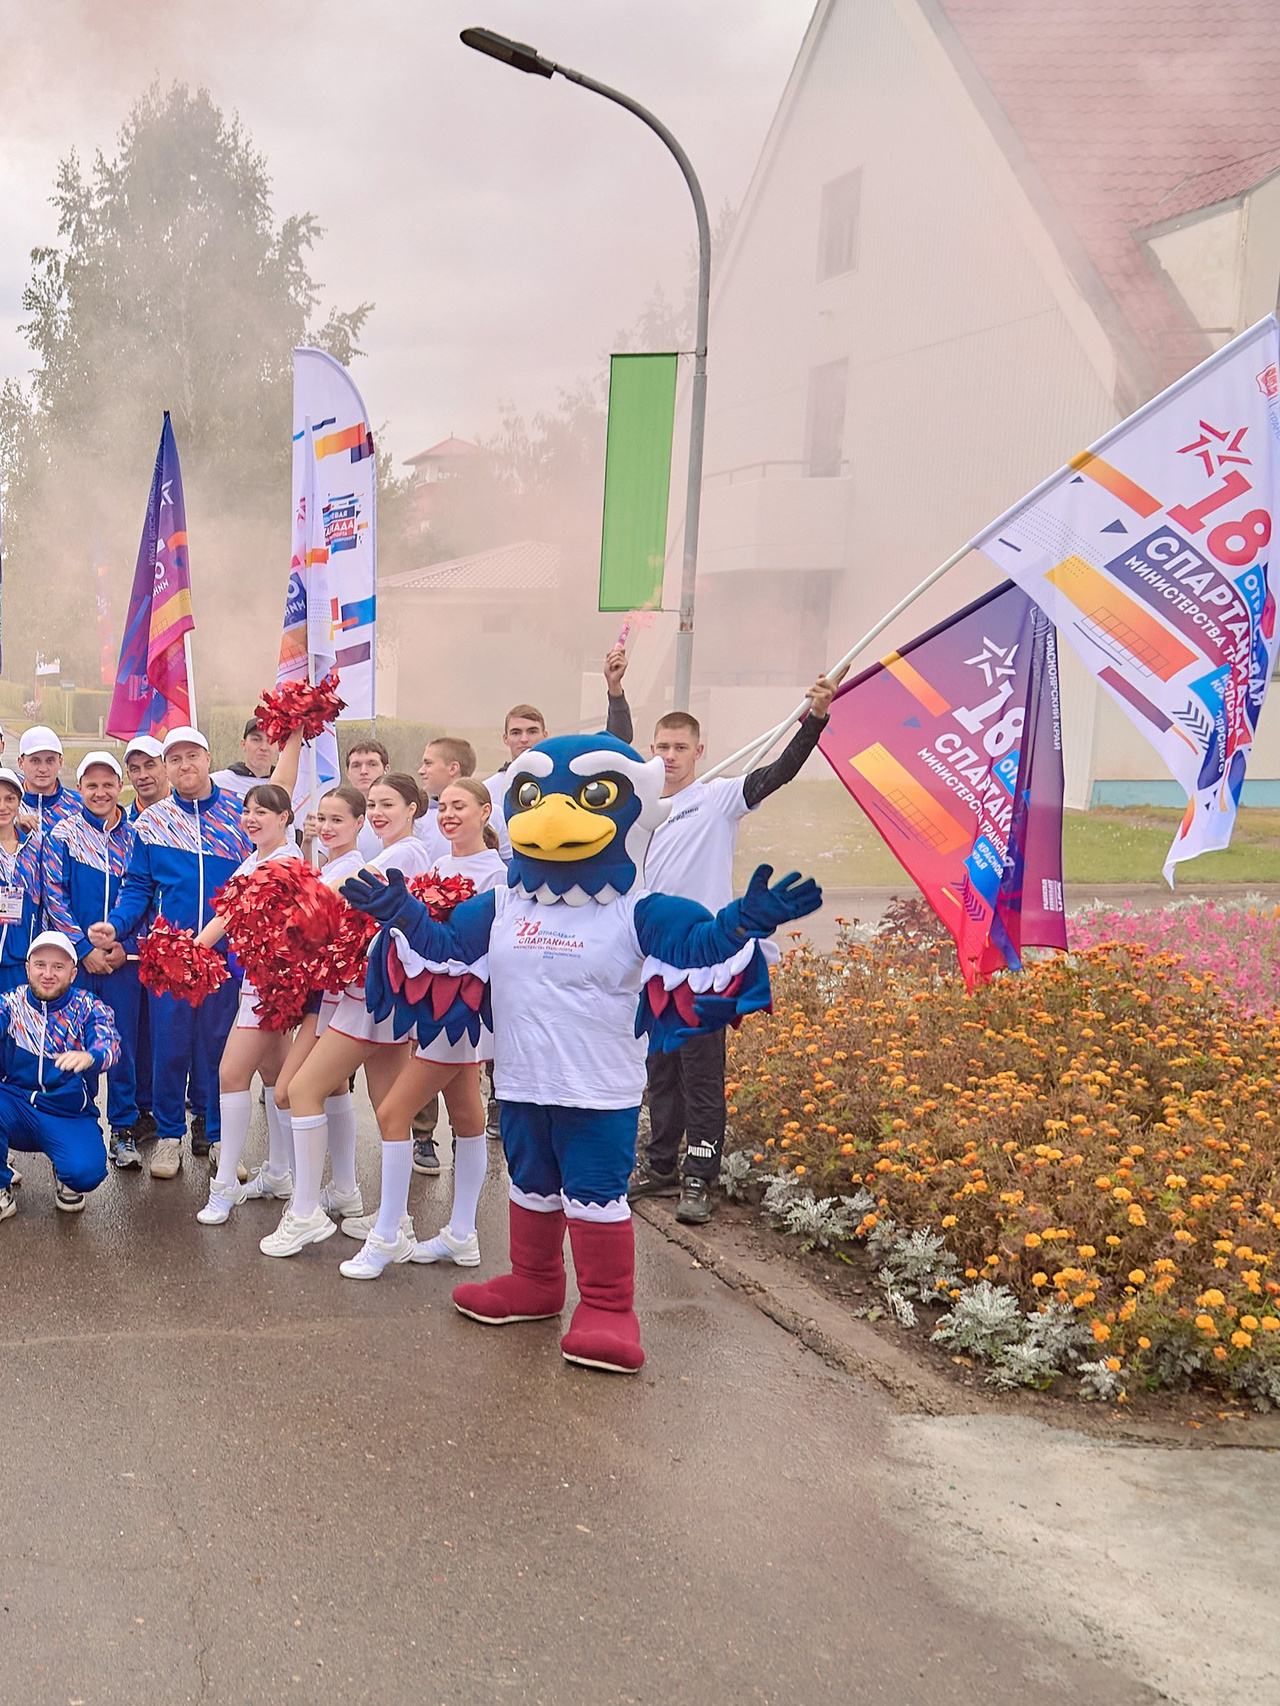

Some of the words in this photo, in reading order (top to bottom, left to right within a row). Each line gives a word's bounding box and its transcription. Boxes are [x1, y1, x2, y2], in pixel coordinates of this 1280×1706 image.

[1166, 470, 1272, 566] 18
[1124, 555, 1227, 648] МИНИСТЕРСТВА
[951, 680, 1026, 758] 18
[1046, 632, 1060, 719] КРАСНОЯРСКИЙ
[1053, 721, 1061, 751] КРАЙ
[518, 937, 584, 948] СПАРТАКИАДА
